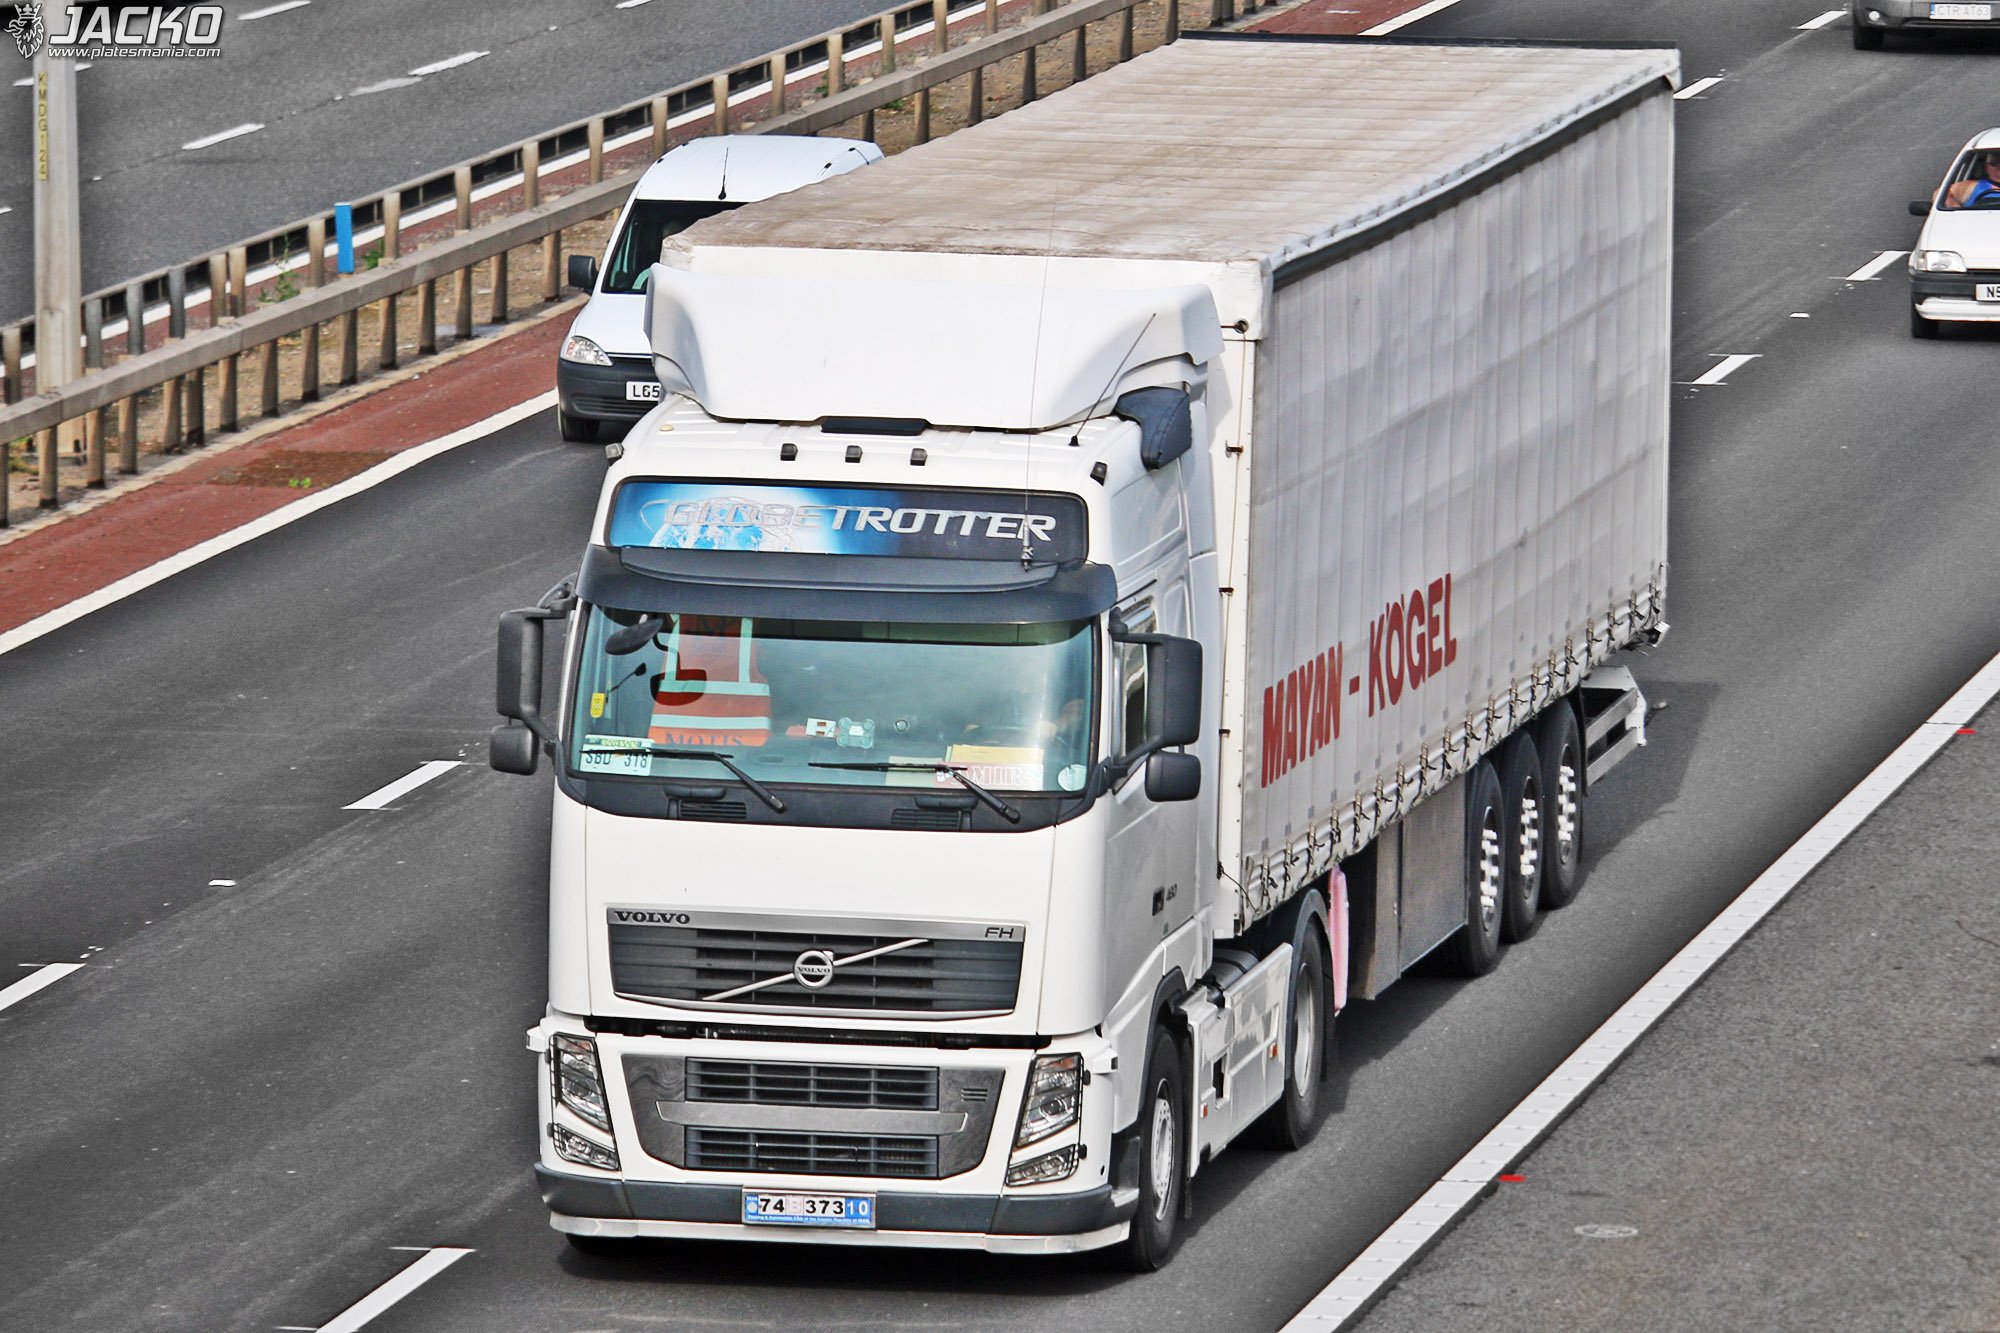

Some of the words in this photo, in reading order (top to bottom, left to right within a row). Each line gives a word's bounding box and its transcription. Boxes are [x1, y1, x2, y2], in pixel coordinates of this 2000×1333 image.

[664, 499, 1057, 542] GLOBETROTTER
[1261, 641, 1343, 788] MAYAN
[1368, 573, 1457, 718] KÖGEL
[614, 911, 690, 924] VOLVO
[984, 927, 1014, 939] FH
[759, 1198, 785, 1213] 74
[805, 1199, 844, 1215] 373
[847, 1199, 869, 1216] 10
